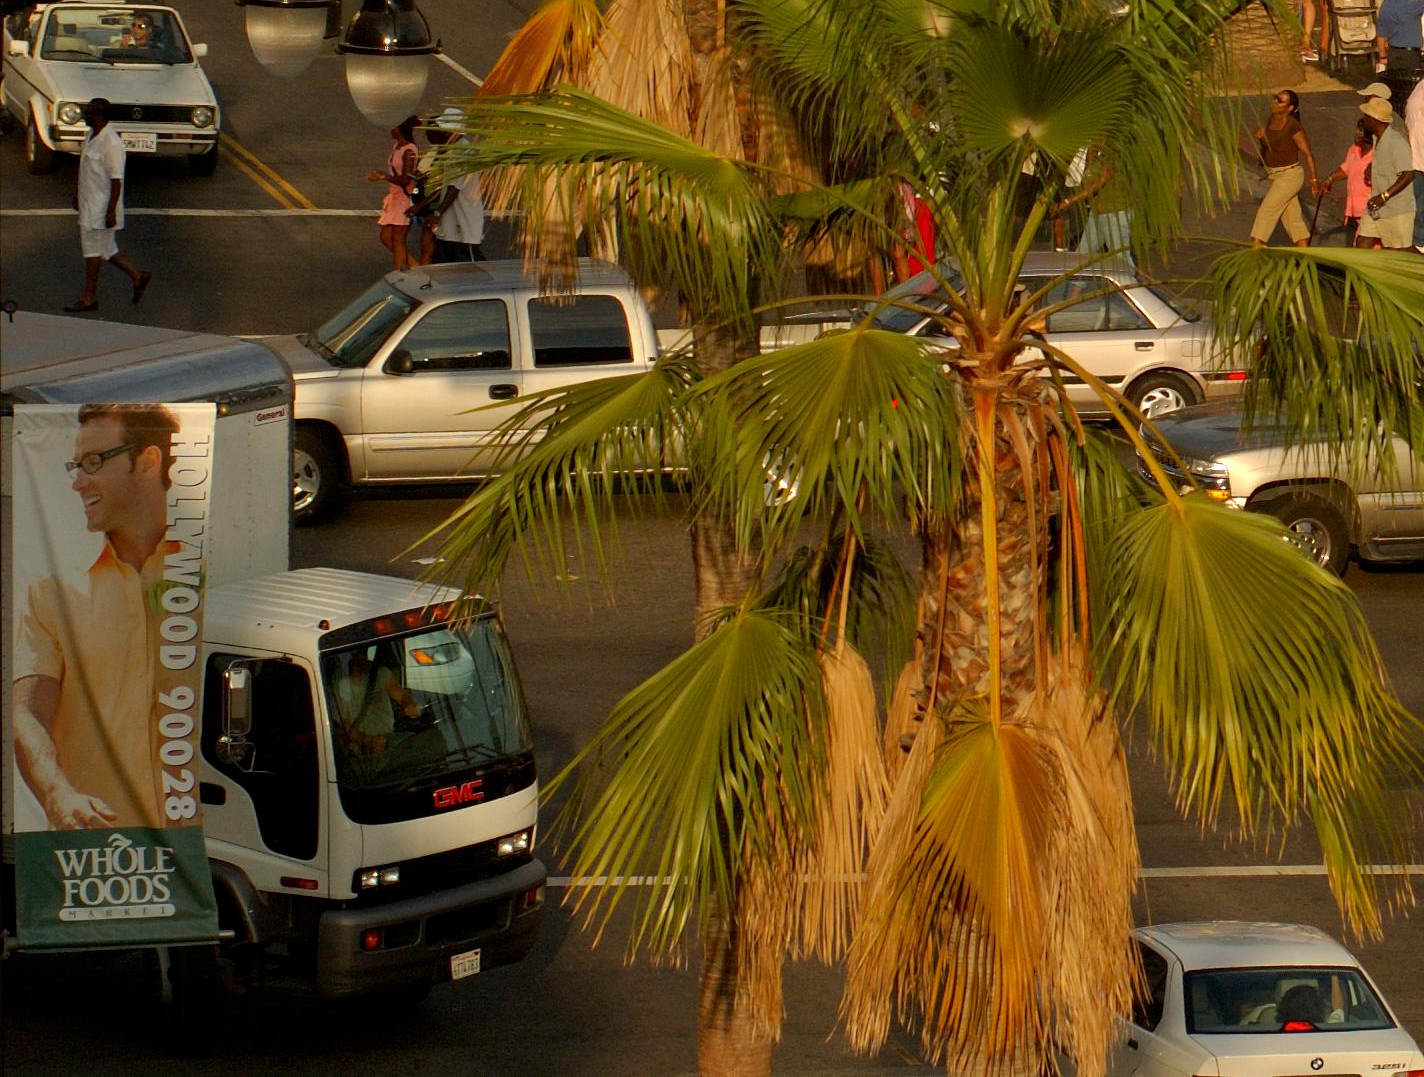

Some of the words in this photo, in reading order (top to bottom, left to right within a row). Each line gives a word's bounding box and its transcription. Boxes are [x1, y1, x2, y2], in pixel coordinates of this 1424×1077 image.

[160, 433, 210, 670] HOLLYWOOD
[158, 685, 196, 821] 90028
[433, 779, 485, 808] GMC
[54, 841, 176, 877] WHOLE
[63, 874, 171, 907] FOODS
[68, 905, 168, 919] MARKET
